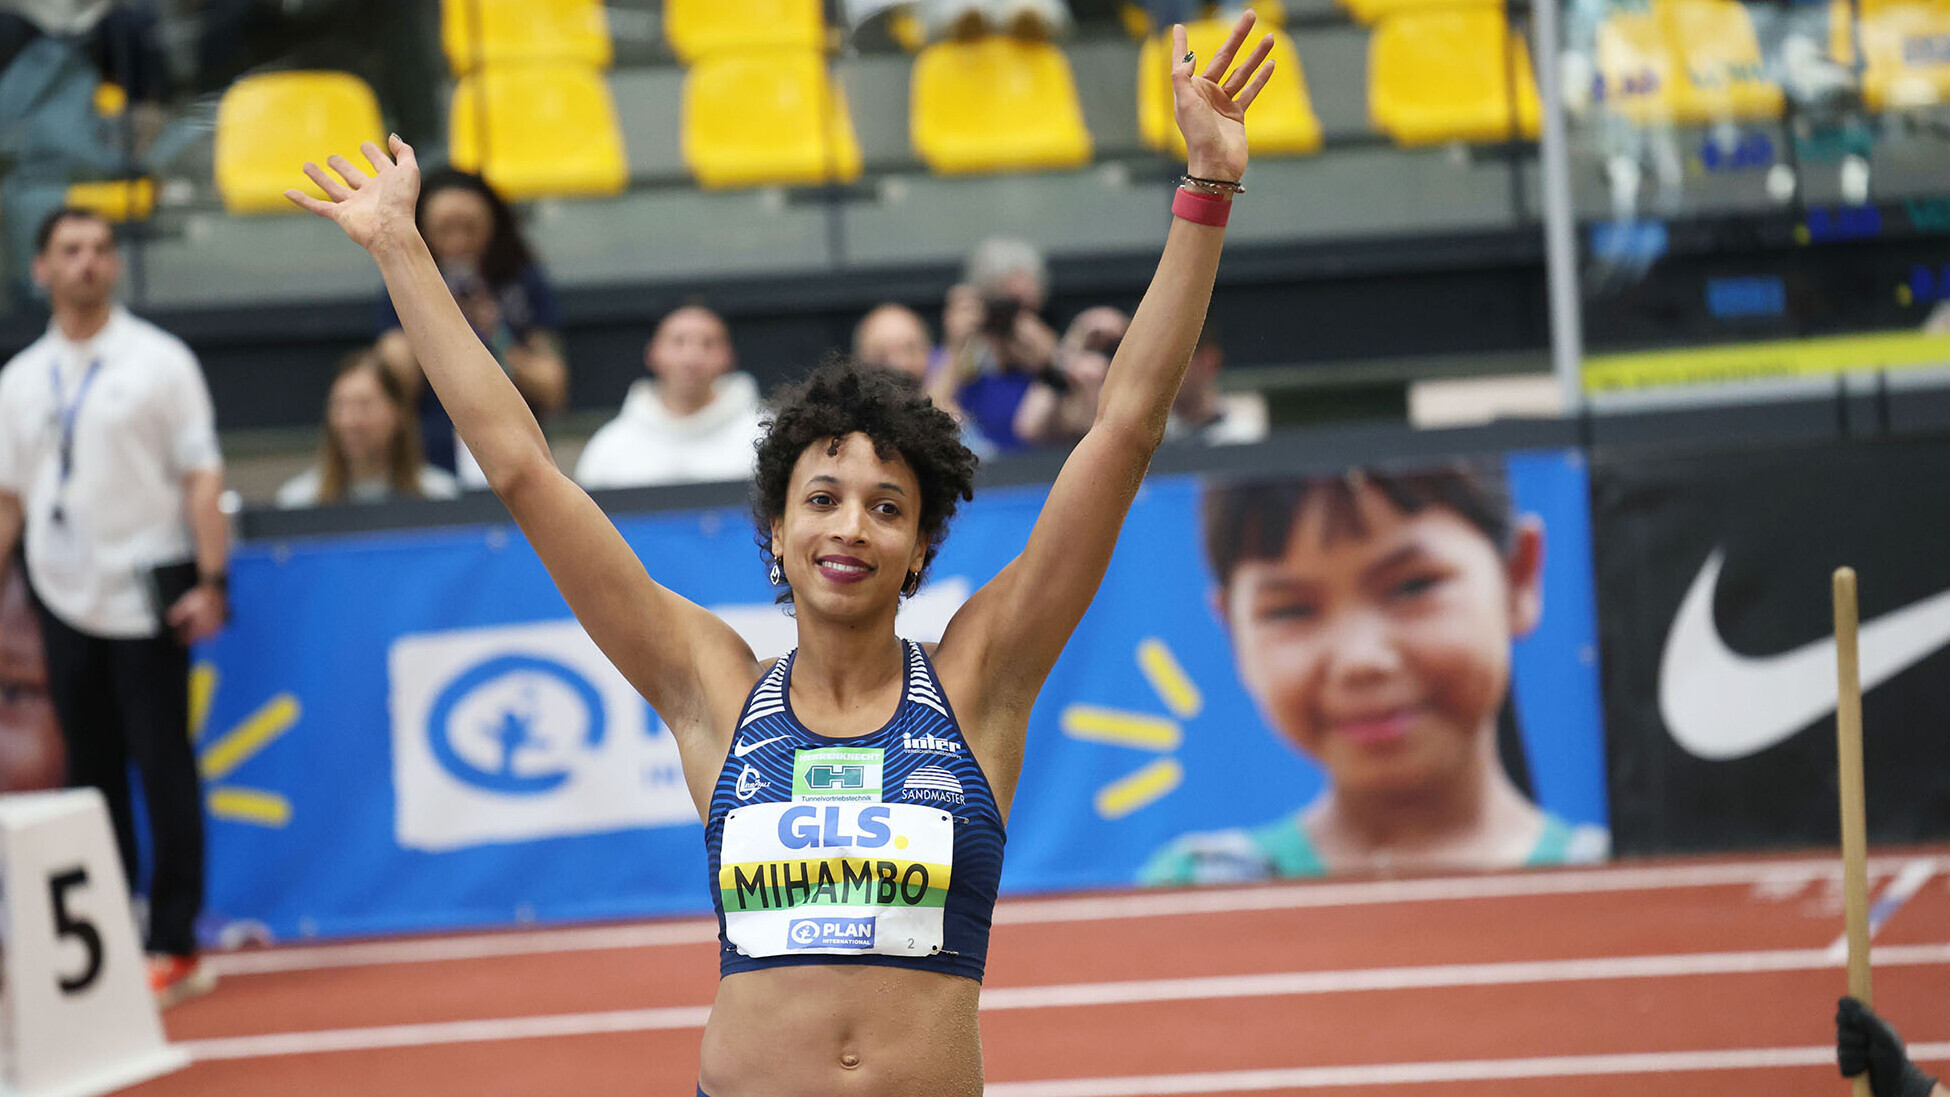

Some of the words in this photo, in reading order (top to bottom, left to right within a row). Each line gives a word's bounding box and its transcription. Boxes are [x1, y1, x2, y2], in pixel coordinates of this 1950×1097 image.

[903, 732, 961, 752] inter
[799, 752, 881, 762] HERRENKNECHT
[901, 788, 966, 805] SANDMASTER
[734, 859, 929, 909] MIHAMBO
[49, 867, 105, 996] 5
[822, 922, 872, 938] PLAN
[822, 938, 871, 946] INTERNATIONAL
[907, 938, 915, 950] 2
